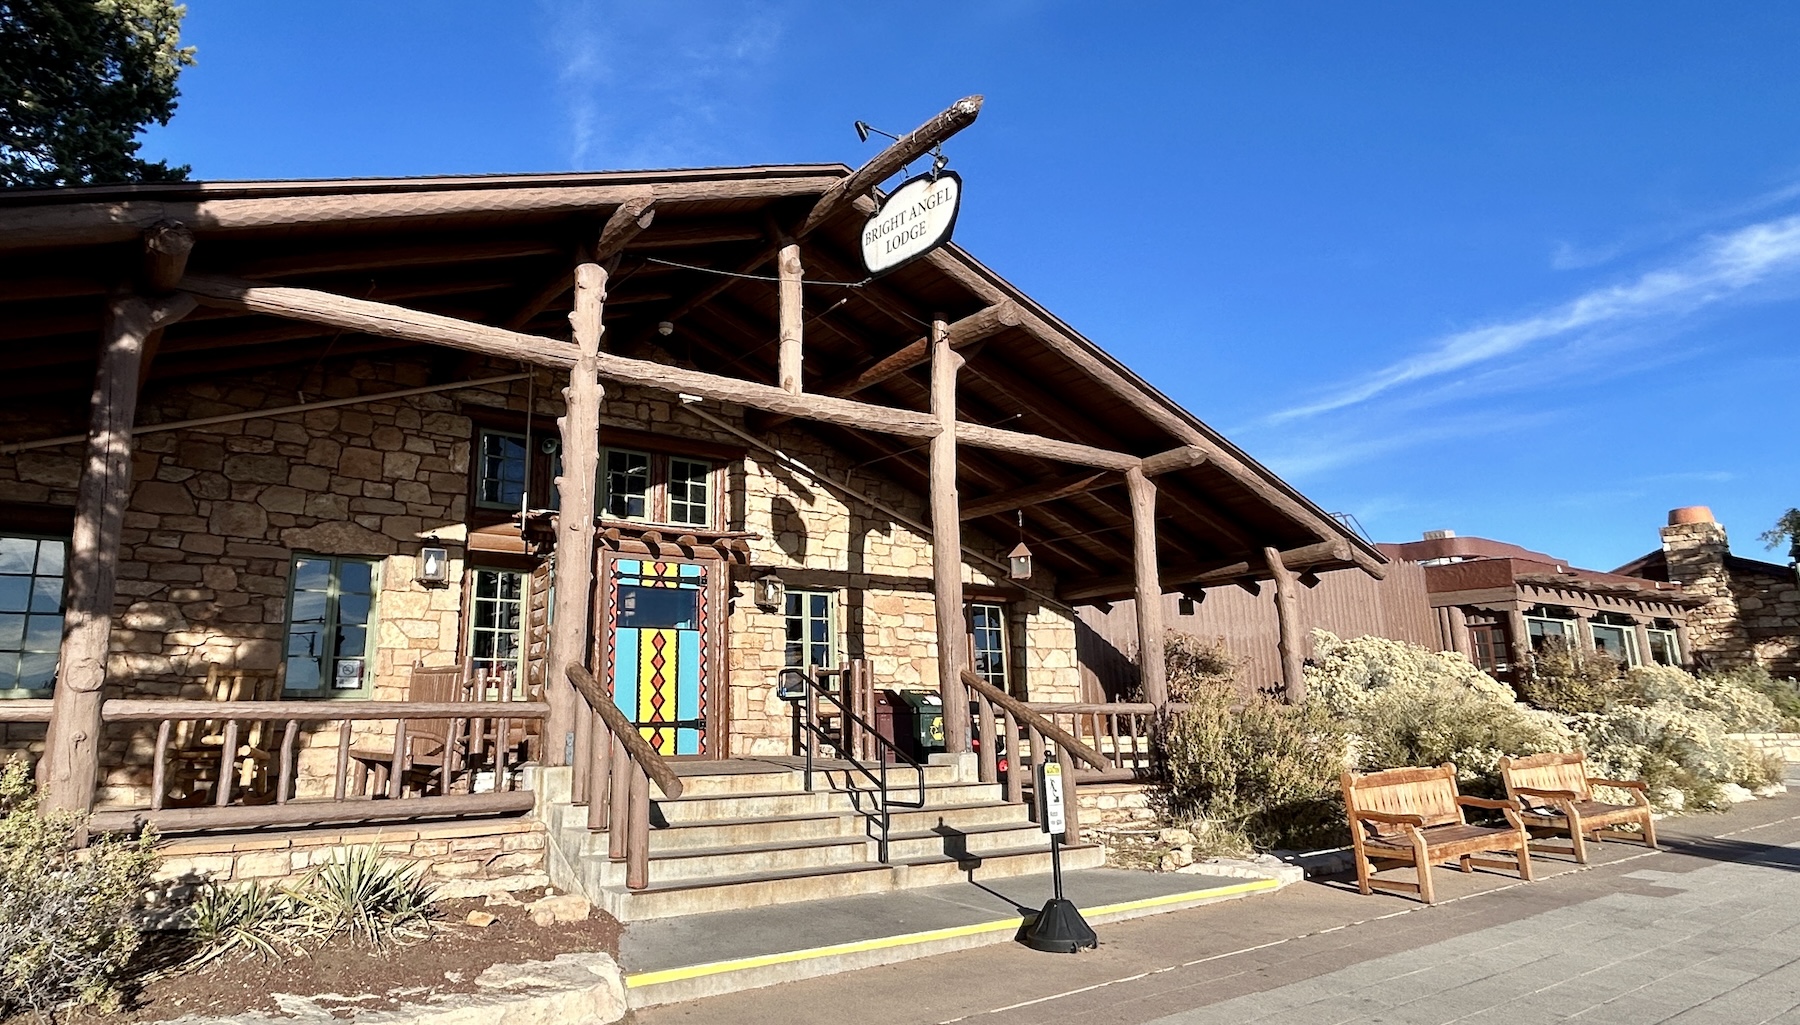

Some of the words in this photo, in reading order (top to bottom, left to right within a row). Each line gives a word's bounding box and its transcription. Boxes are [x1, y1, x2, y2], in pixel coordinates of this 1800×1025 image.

[865, 210, 907, 246] BRIGHT
[909, 187, 953, 221] ANGEL
[886, 221, 927, 254] LODGE
